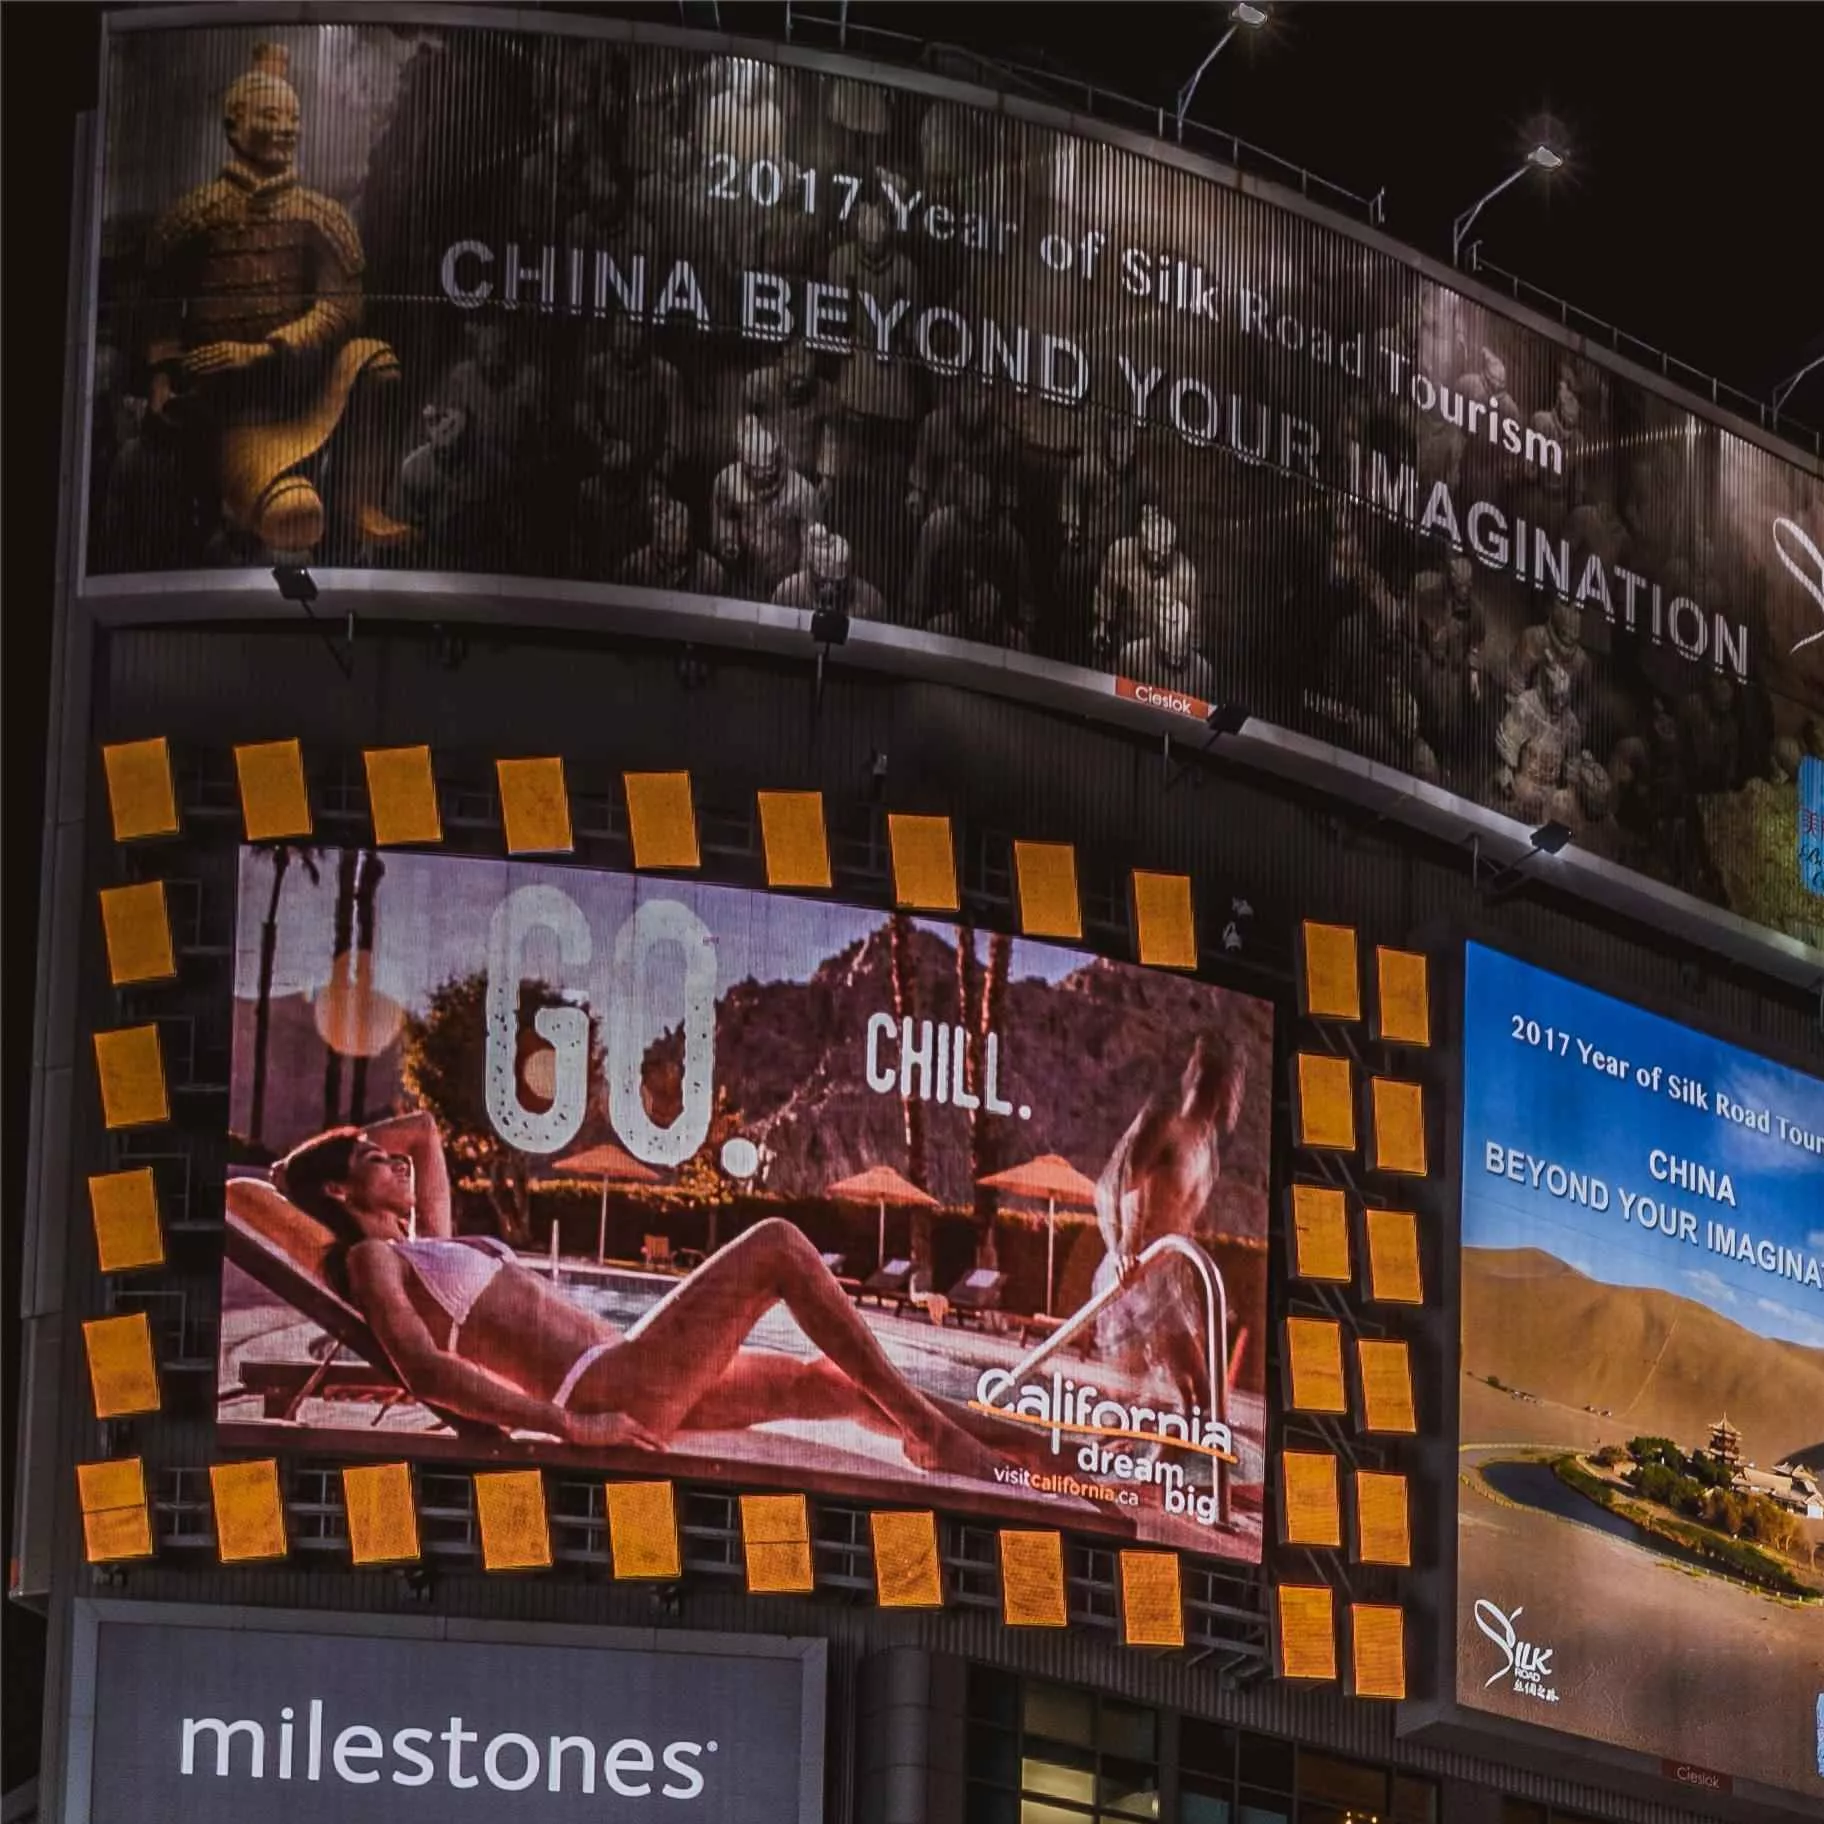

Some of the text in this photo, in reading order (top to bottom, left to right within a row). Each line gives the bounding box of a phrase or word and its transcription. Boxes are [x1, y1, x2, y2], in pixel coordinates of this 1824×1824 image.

[706, 152, 1563, 475] 2017 Year of Silk Road Tourism
[440, 239, 1749, 685] CHINA BEYOND YOUR IMAGINATION
[485, 884, 759, 1178] GO.
[866, 1012, 1032, 1121] CHILL.
[1511, 1015, 1570, 1057] 2017
[1576, 1038, 1630, 1079] Year
[1636, 1066, 1664, 1092] of
[1668, 1074, 1709, 1110] Silk
[1716, 1092, 1770, 1134] Road
[1485, 1141, 1609, 1212] BEYOND
[1618, 1188, 1698, 1245] YOUR
[1648, 1149, 1737, 1207] CHINA
[976, 1368, 1233, 1456] California
[994, 1466, 1139, 1506] visitcalifornia.ca
[1077, 1443, 1184, 1489] dream
[1164, 1475, 1220, 1525] big
[1514, 1668, 1542, 1683] ROAD
[180, 1698, 706, 1801] milestones
